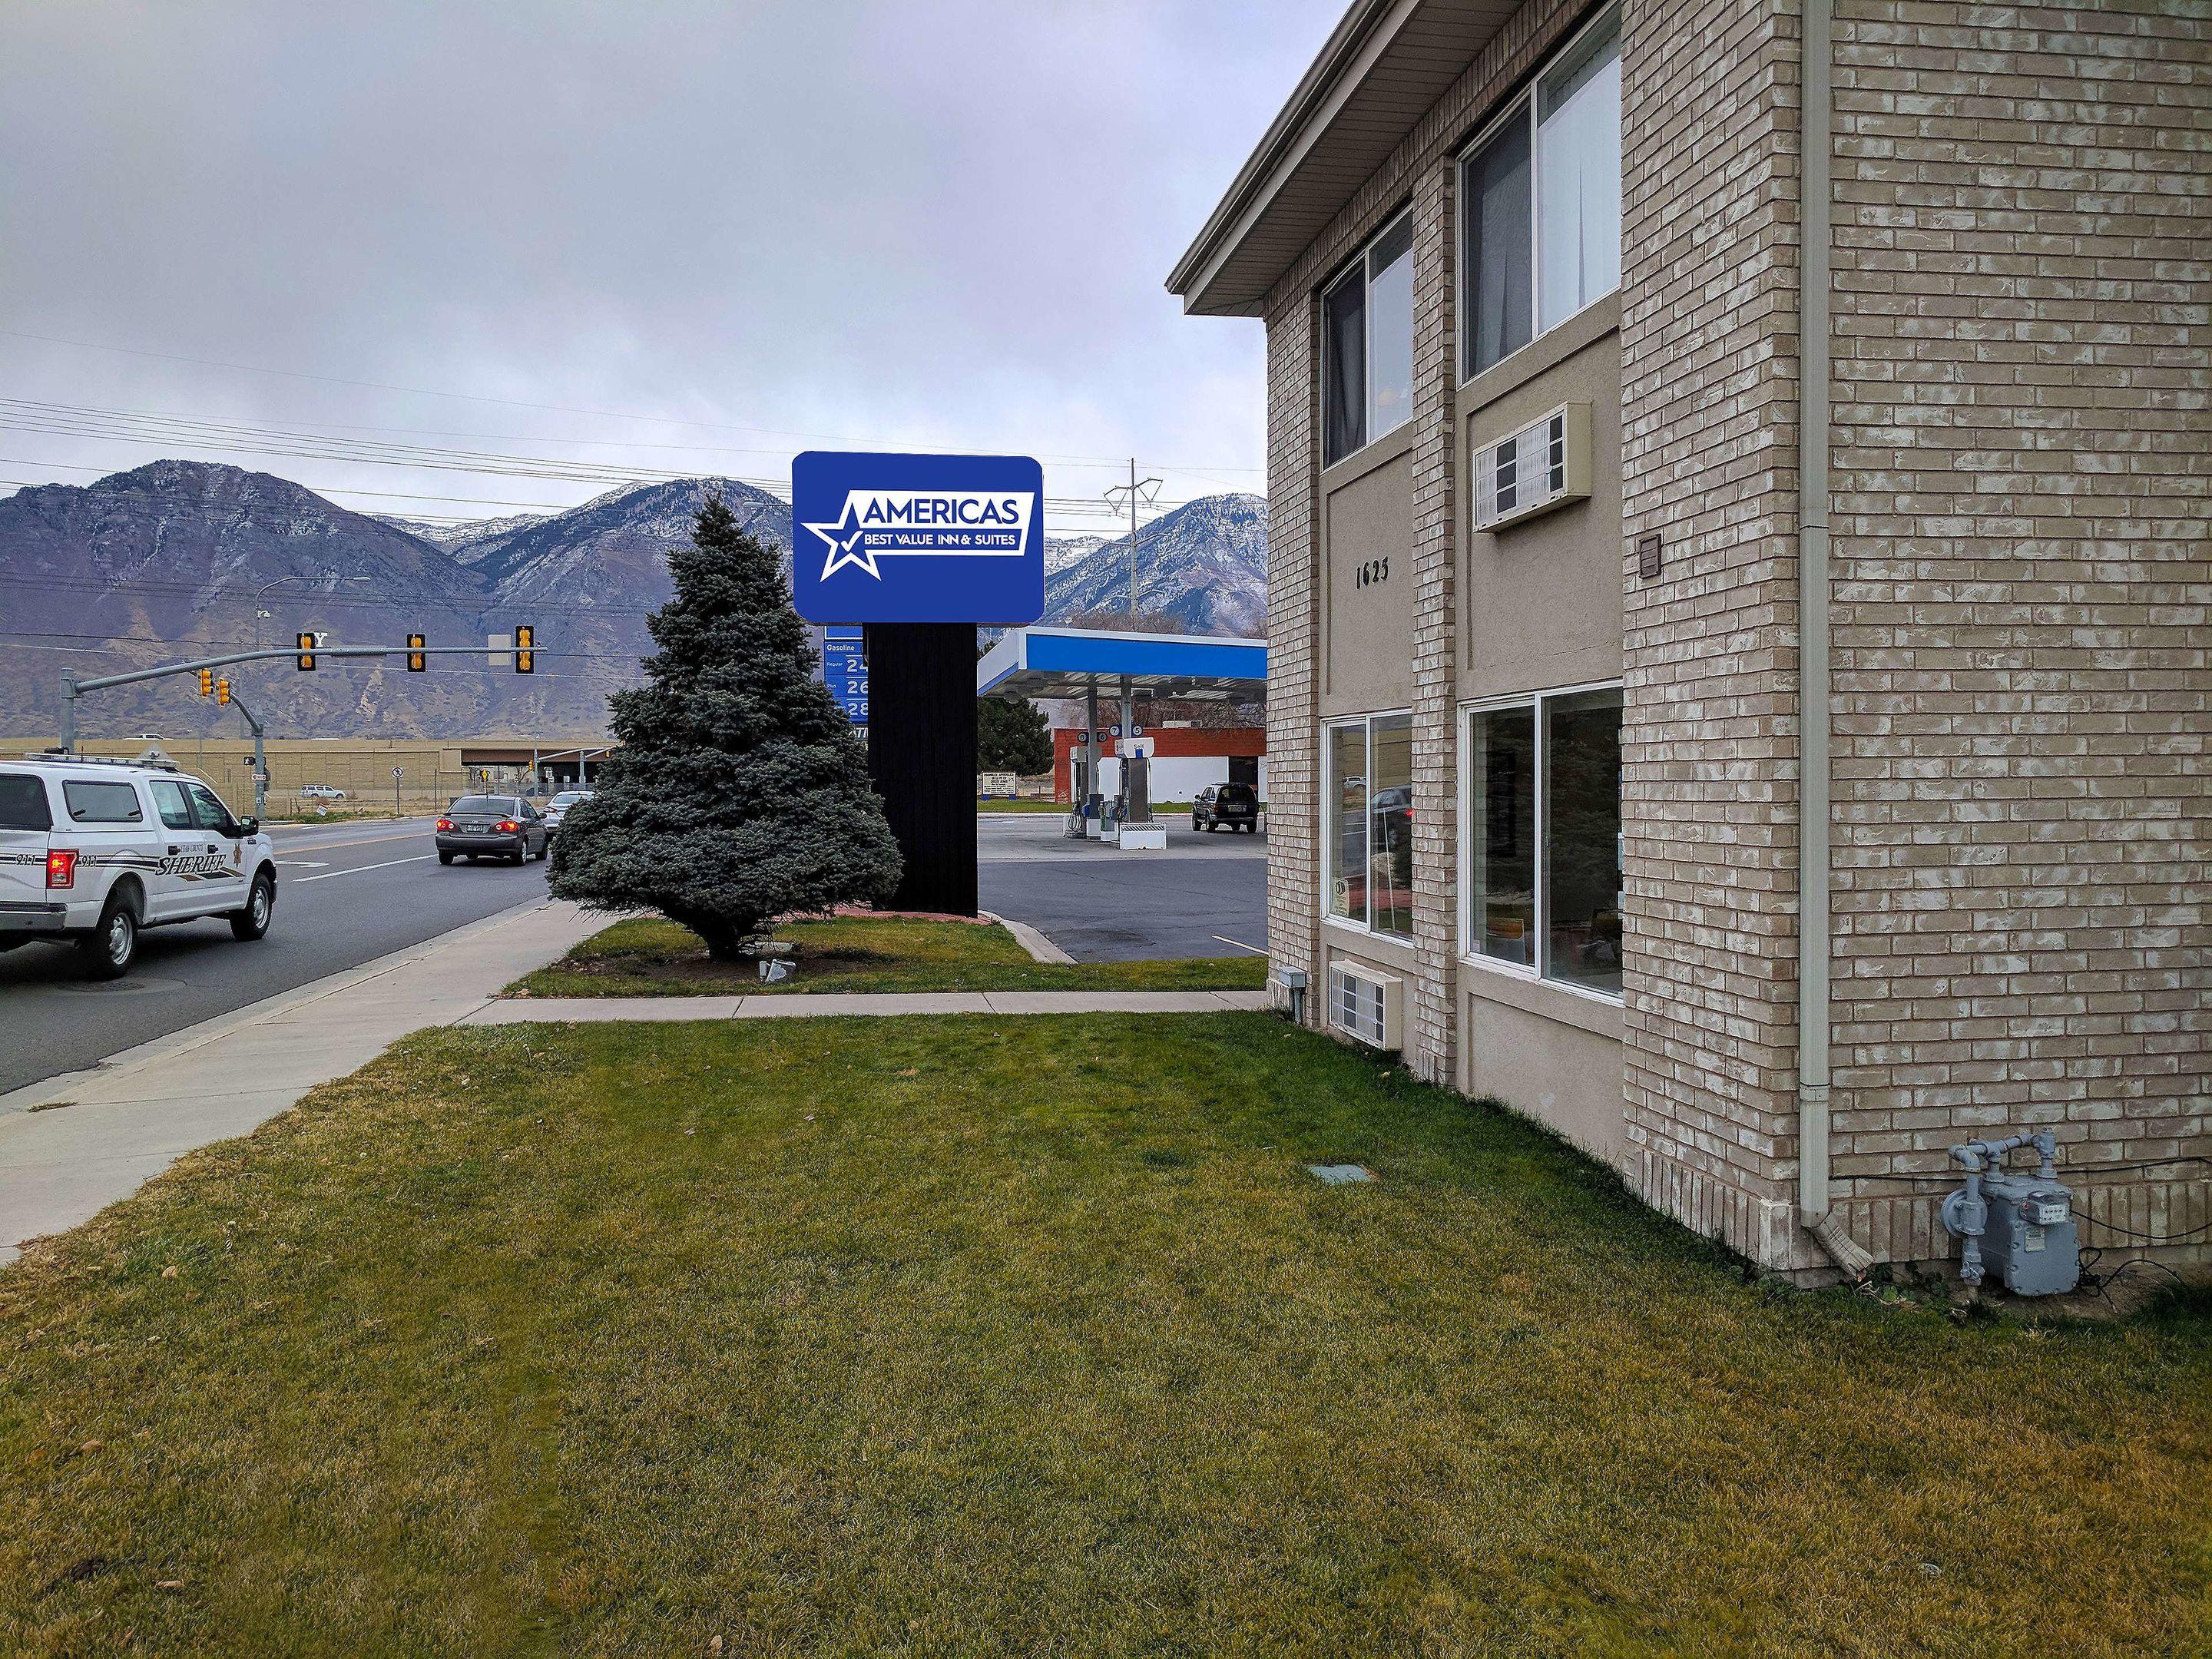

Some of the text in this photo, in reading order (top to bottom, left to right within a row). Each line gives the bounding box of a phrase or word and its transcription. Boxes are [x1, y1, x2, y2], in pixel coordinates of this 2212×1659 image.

[863, 498, 1019, 525] AMERICAS
[864, 534, 1016, 545] BEST VALUE INN & SUITES
[1356, 556, 1389, 590] 1625
[313, 632, 328, 647] Y
[17, 854, 36, 866] 911
[81, 855, 98, 867] 911
[154, 854, 227, 876] SHERIFF
